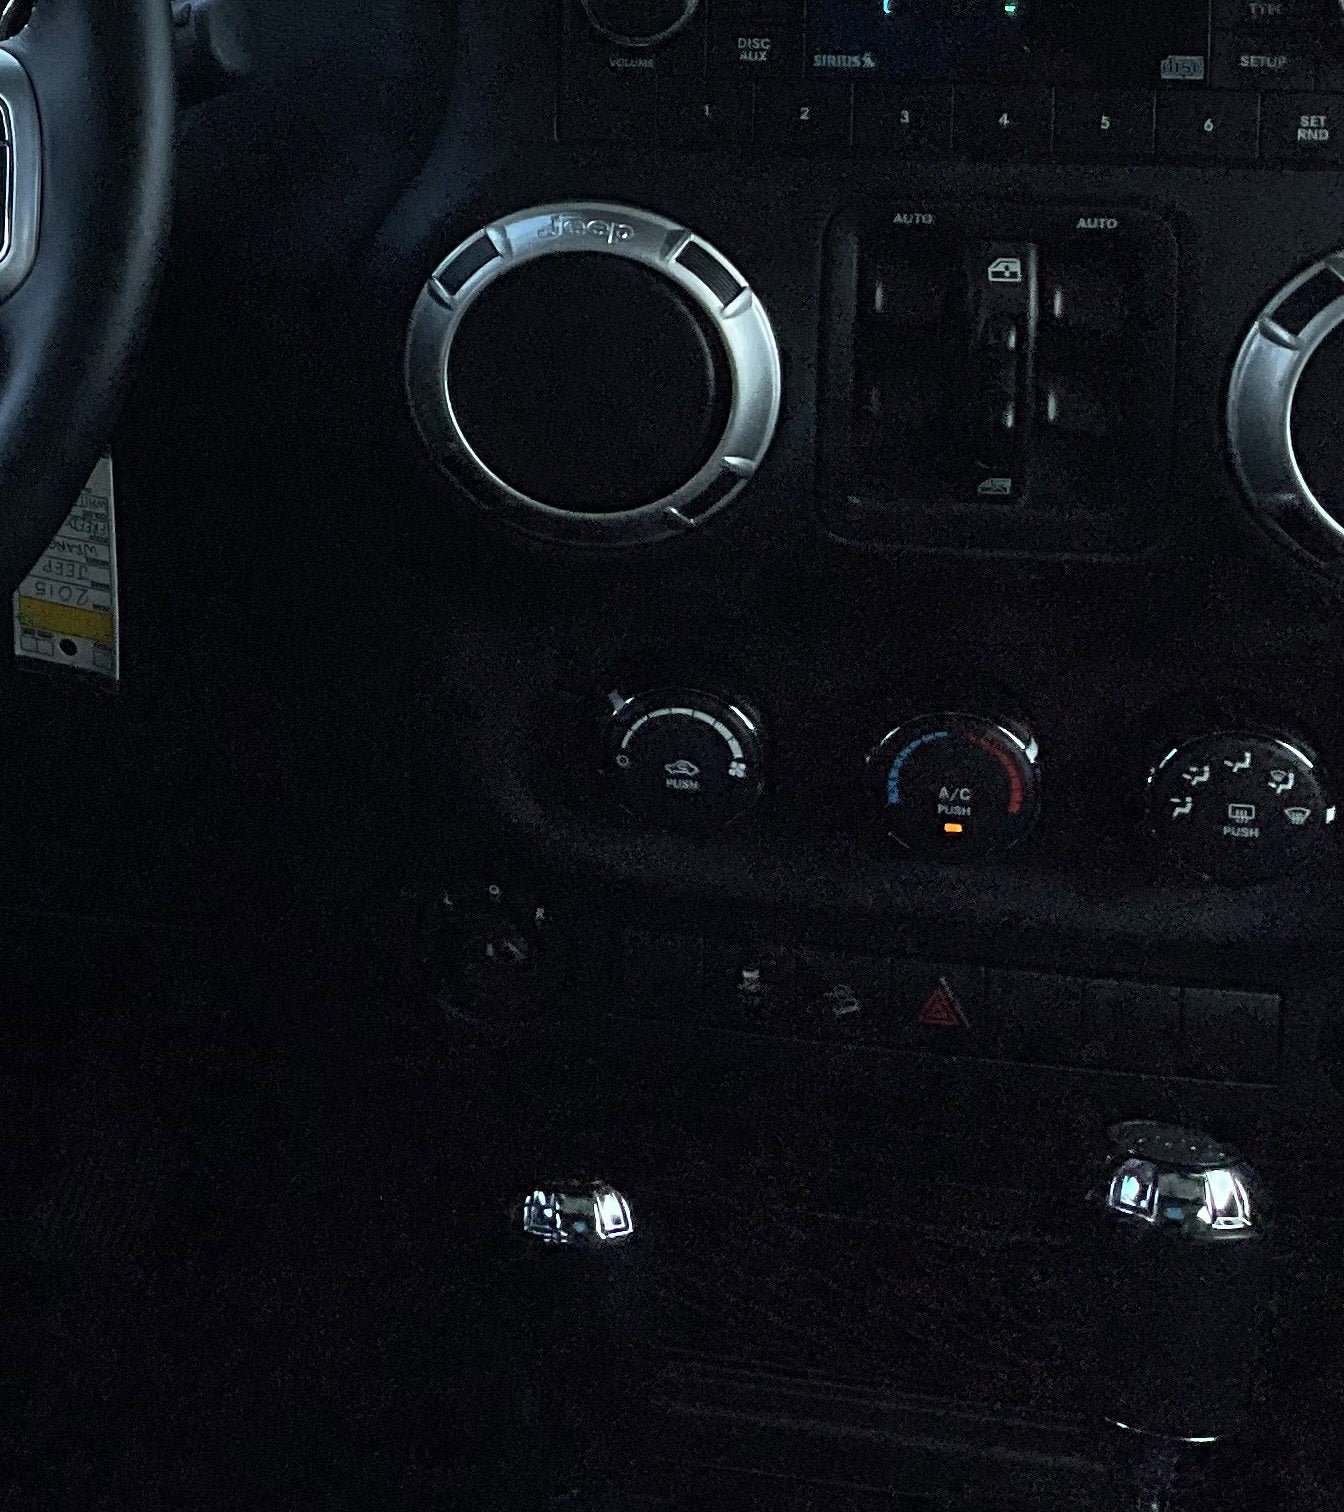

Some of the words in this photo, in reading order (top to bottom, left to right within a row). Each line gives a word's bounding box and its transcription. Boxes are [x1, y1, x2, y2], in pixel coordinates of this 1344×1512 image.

[737, 36, 772, 49] DISC
[1239, 54, 1288, 69] SETUP
[703, 103, 711, 117] 1
[799, 107, 810, 121] 2
[900, 110, 910, 124] 3
[998, 112, 1010, 127] 4
[1100, 115, 1111, 129] 5
[1203, 118, 1214, 132] 6
[1300, 115, 1328, 128] SET
[1297, 127, 1330, 141] RND
[892, 212, 934, 225] AUTO
[1075, 217, 1120, 229] AUTO
[537, 215, 635, 245] Jeep
[34, 580, 89, 607] 2015
[937, 786, 971, 802] A/C
[937, 803, 972, 816] PUSH
